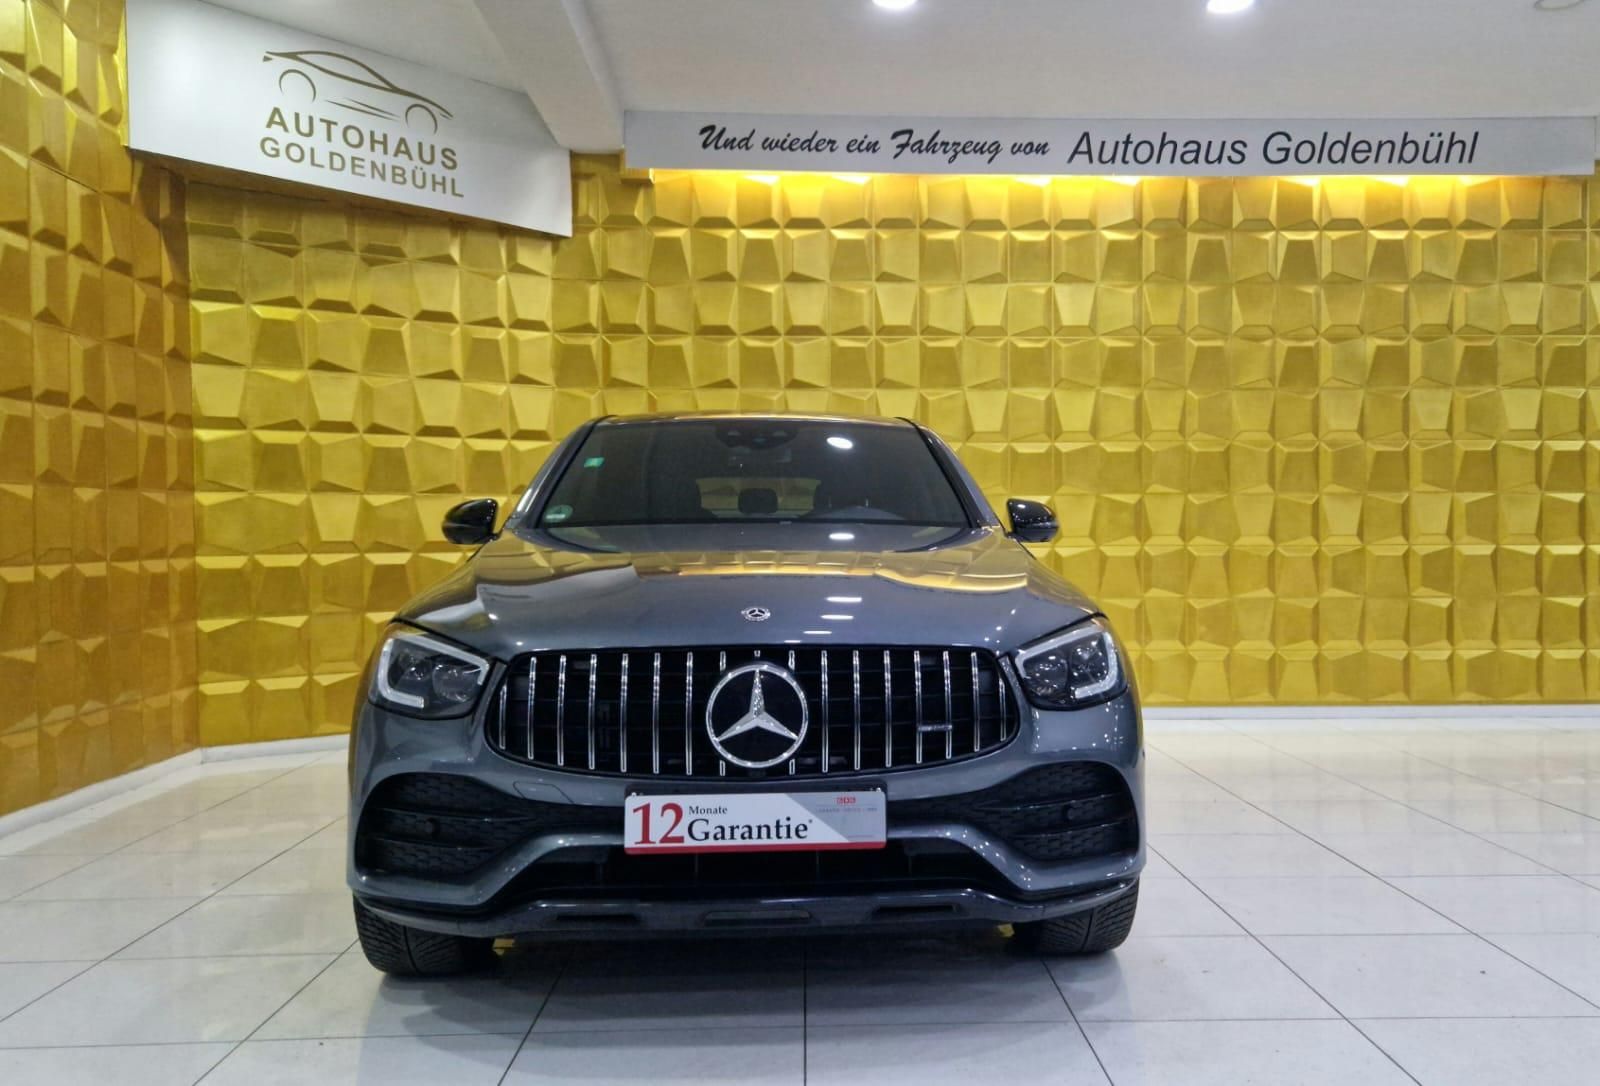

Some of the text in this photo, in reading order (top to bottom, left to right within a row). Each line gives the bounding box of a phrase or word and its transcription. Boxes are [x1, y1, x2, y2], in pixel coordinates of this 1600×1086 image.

[265, 106, 459, 171] AUTOHAUS
[698, 124, 1480, 165] Und wieder ein Fahrzeug von Autohaus Goldenbühl
[259, 136, 465, 198] GOLDENBÜHL
[632, 802, 685, 845] 12
[688, 805, 728, 815] Monate
